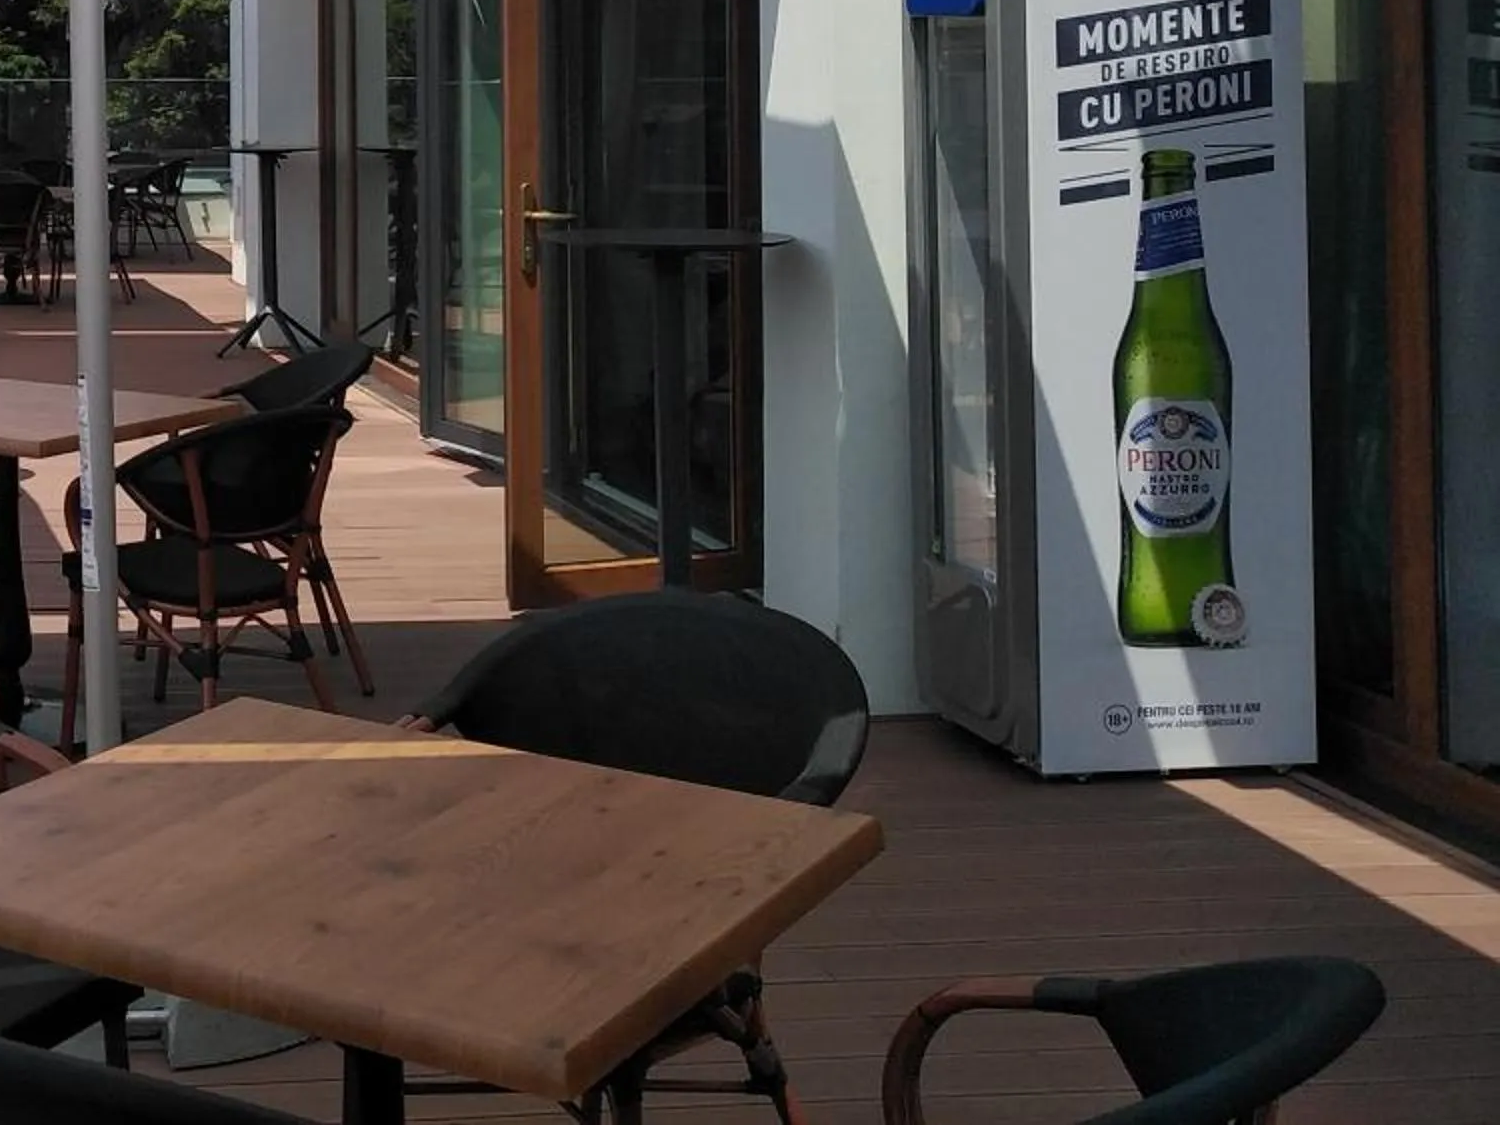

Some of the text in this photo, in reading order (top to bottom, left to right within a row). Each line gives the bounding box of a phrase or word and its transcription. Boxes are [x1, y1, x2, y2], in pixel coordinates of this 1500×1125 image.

[1101, 46, 1230, 83] DE RESPIRO
[1080, 70, 1252, 129] CU PERONI
[1127, 448, 1221, 472] PERONI
[1140, 483, 1211, 496] AZZURRO
